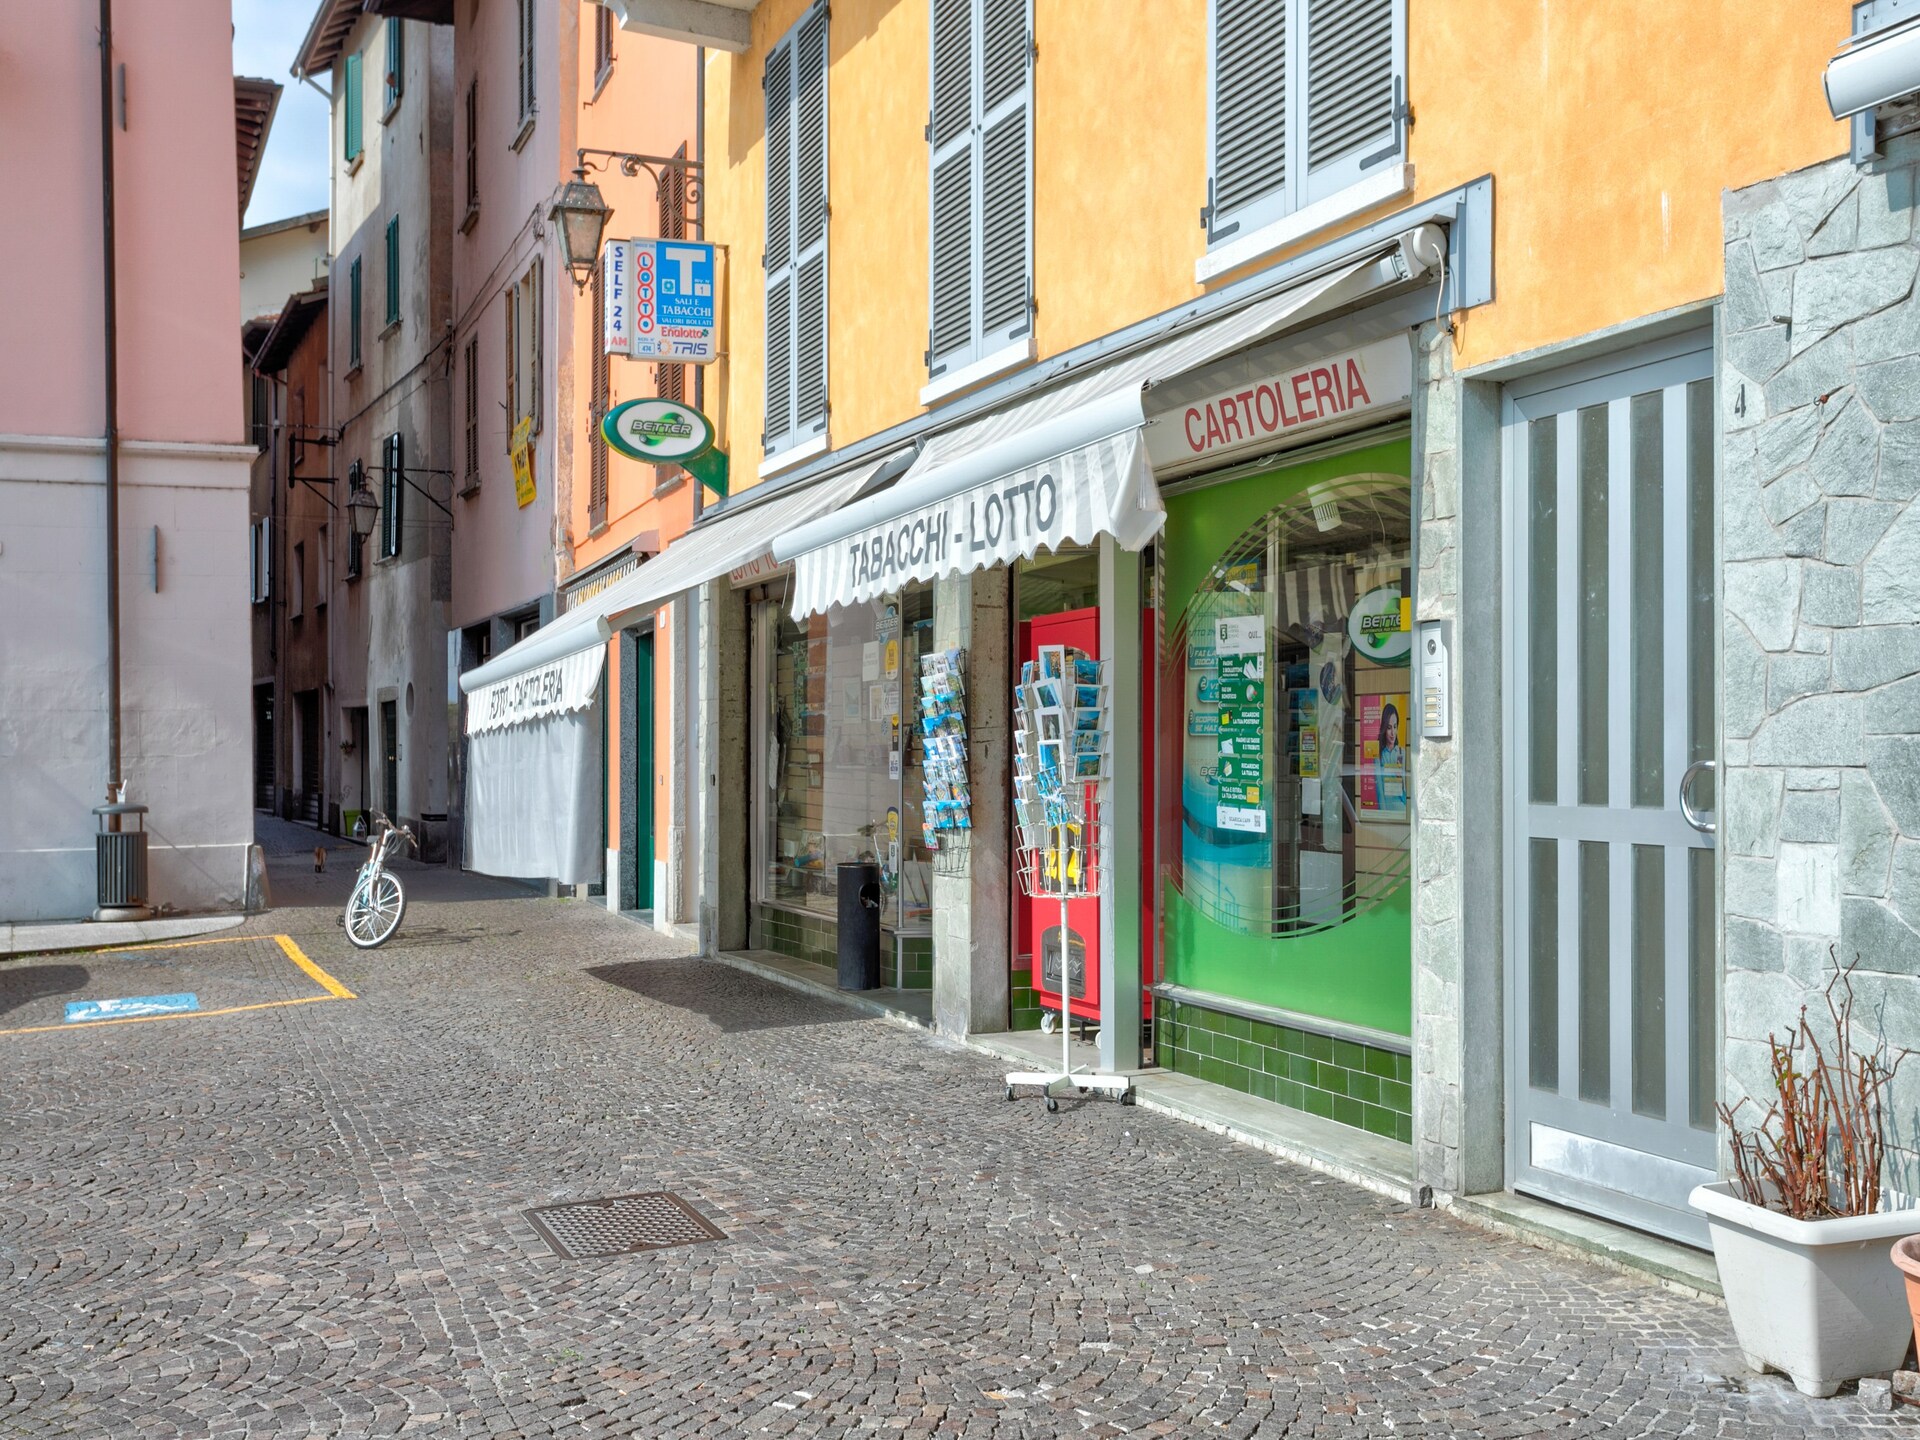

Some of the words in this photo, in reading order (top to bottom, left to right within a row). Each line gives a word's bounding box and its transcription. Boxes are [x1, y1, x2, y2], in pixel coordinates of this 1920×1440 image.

[614, 247, 623, 299] SELF
[665, 247, 706, 295] T
[637, 252, 654, 333] LOTTO
[675, 297, 692, 305] SALI
[613, 306, 622, 331] 24
[662, 305, 711, 316] TABACCHI
[661, 317, 684, 325] VALORI
[686, 318, 712, 326] BOLLATI
[661, 326, 703, 339] Enalotto
[673, 341, 708, 355] TRIS
[1184, 358, 1371, 452] CARTOLERIA
[1734, 383, 1747, 418] 4
[632, 420, 692, 435] BETTER
[850, 510, 949, 588] TABACCHI
[970, 473, 1058, 552] LOTTO
[1363, 614, 1401, 628] BETTE
